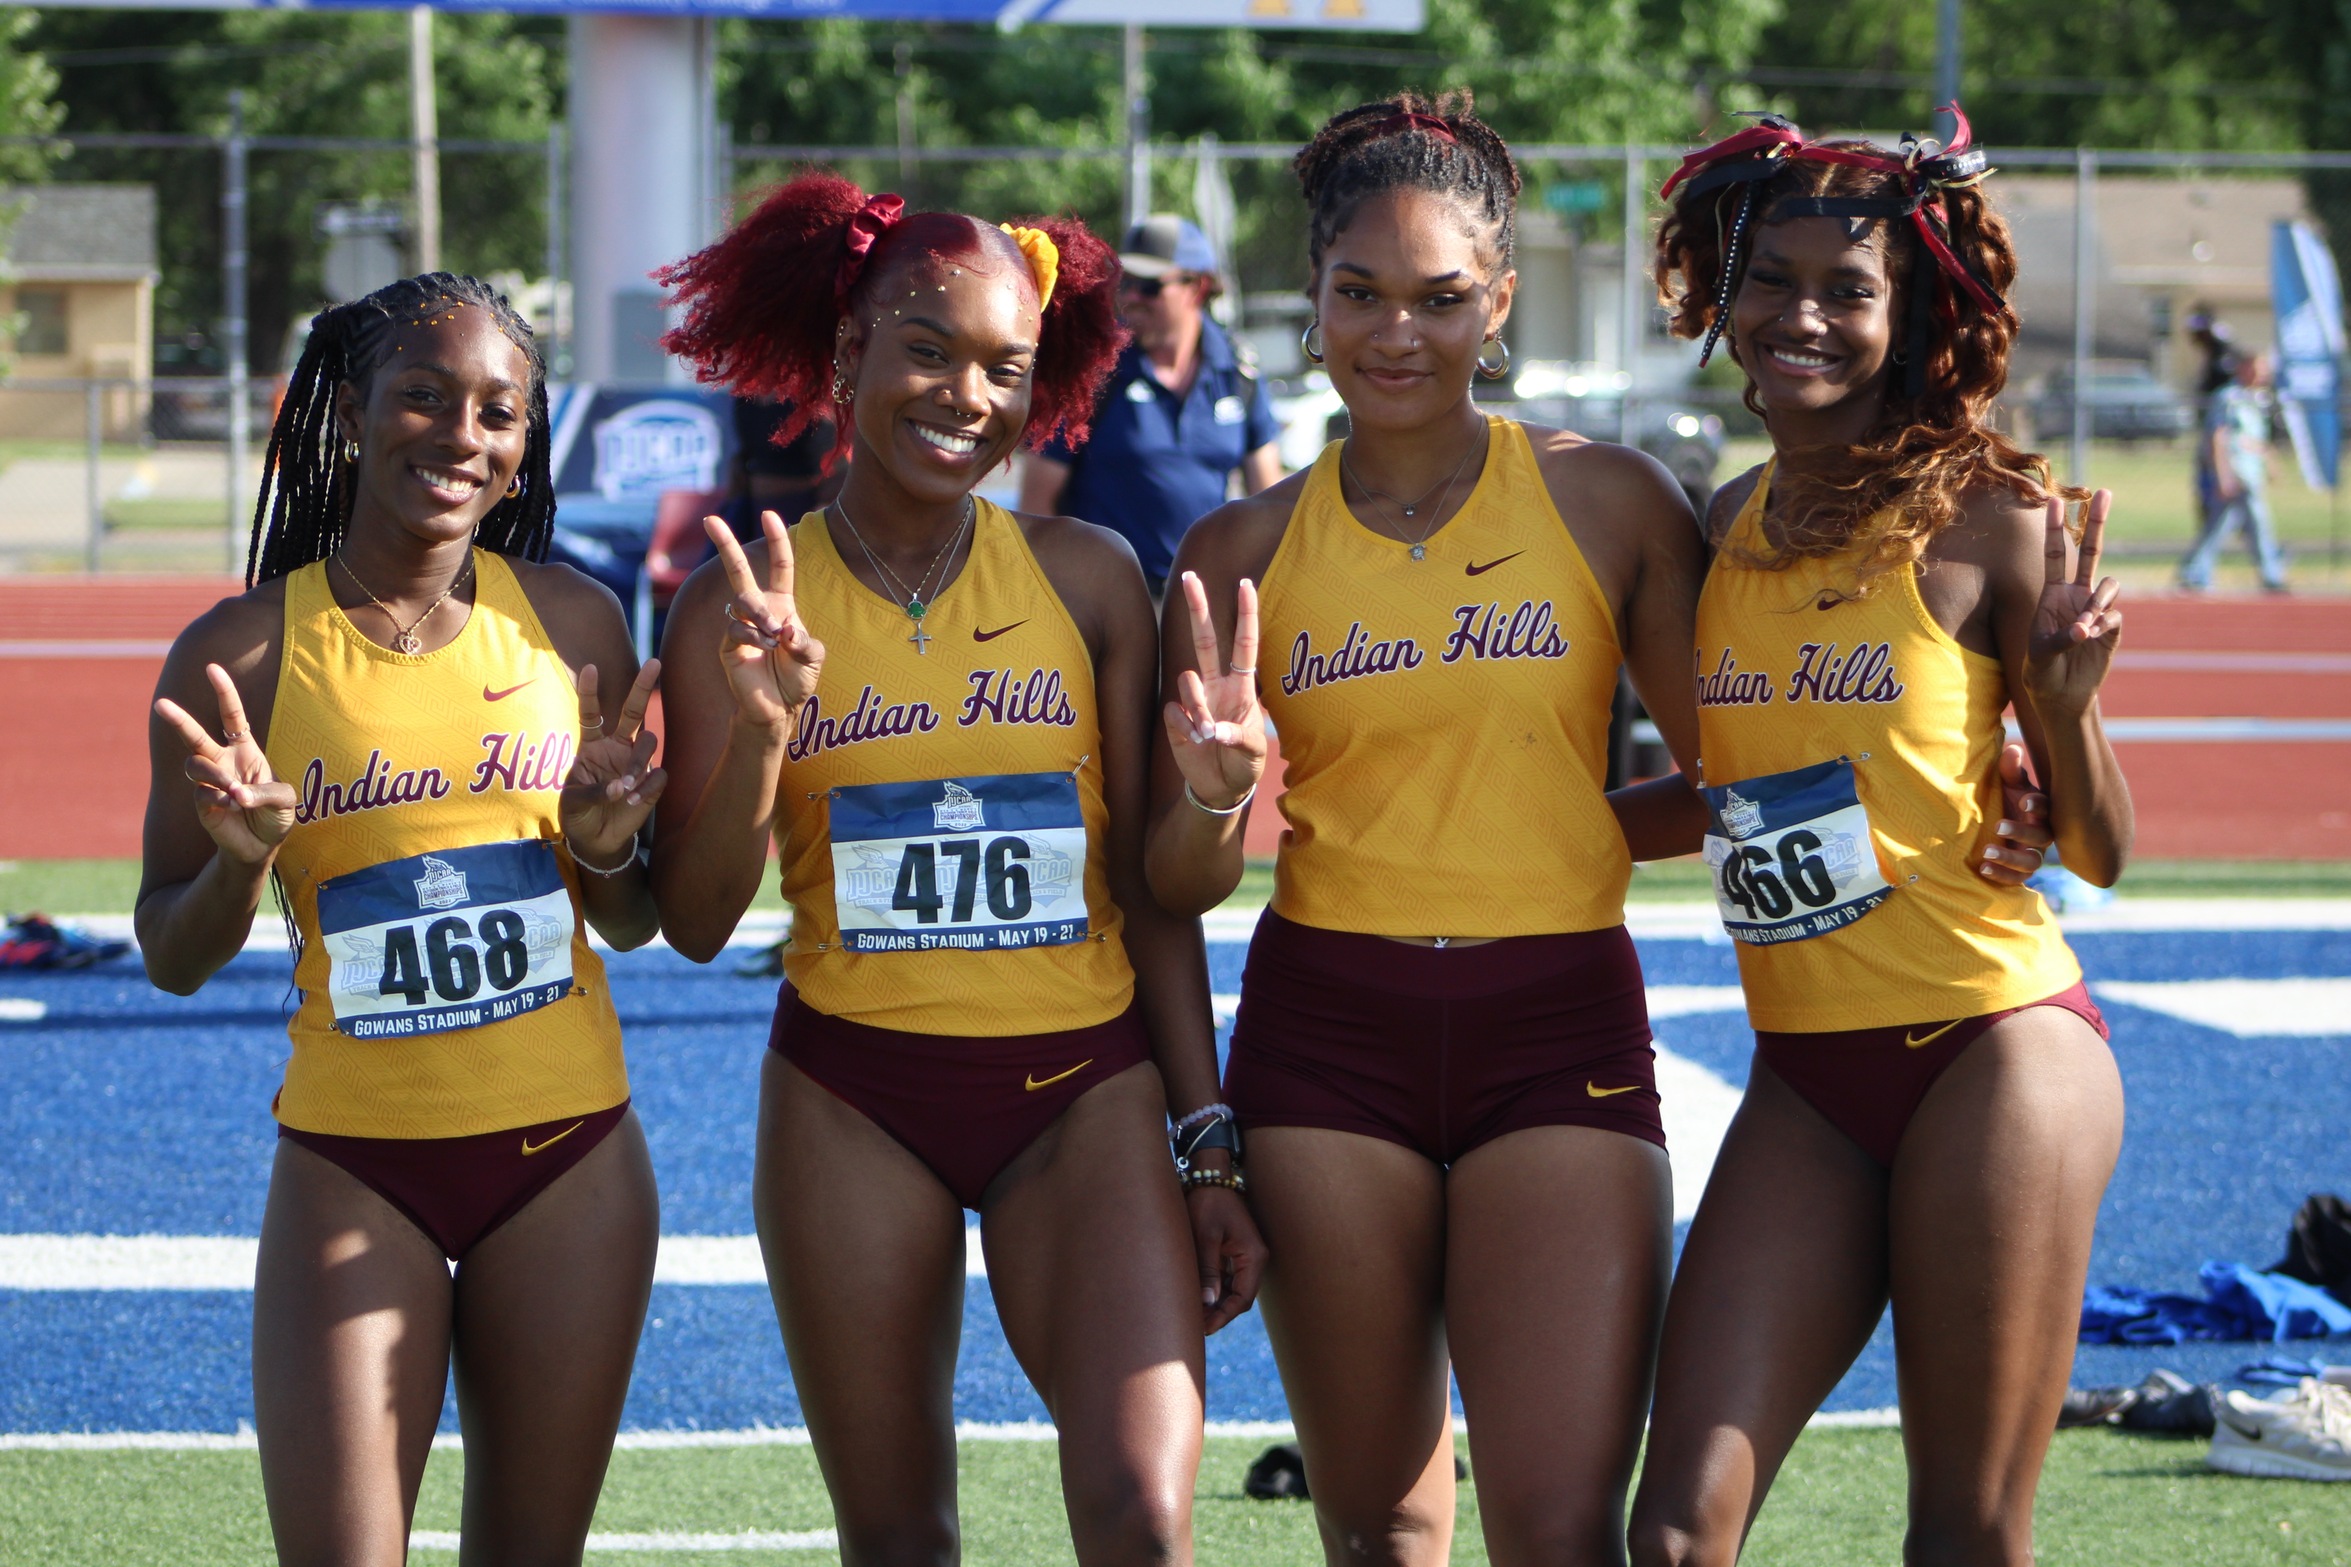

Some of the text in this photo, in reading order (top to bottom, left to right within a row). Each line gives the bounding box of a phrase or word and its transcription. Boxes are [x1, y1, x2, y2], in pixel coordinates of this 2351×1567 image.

[1280, 600, 1569, 697] Indian Hills
[1786, 641, 1904, 704] Hills
[787, 667, 1077, 763] Indian Hills
[295, 731, 577, 826] Indian Hill
[947, 796, 971, 808] NJCAA
[429, 868, 452, 884] NJCAA
[849, 870, 899, 898] NJCA
[892, 836, 1032, 924] 476
[1722, 830, 1836, 919] 466
[858, 933, 916, 950] GOWANS
[920, 933, 984, 949] STADIUM
[998, 929, 1030, 946] MAY
[1034, 927, 1047, 943] 19
[1060, 924, 1074, 940] 21
[1761, 924, 1805, 942] STADIUM
[1812, 911, 1844, 931] MAY
[1842, 906, 1858, 921] 19
[379, 909, 528, 1006] 468
[354, 1018, 414, 1036] GOWANS
[417, 1008, 481, 1031] STADIUM
[492, 1001, 518, 1019] MAY
[520, 993, 533, 1009] 19
[546, 985, 559, 1003] 21
